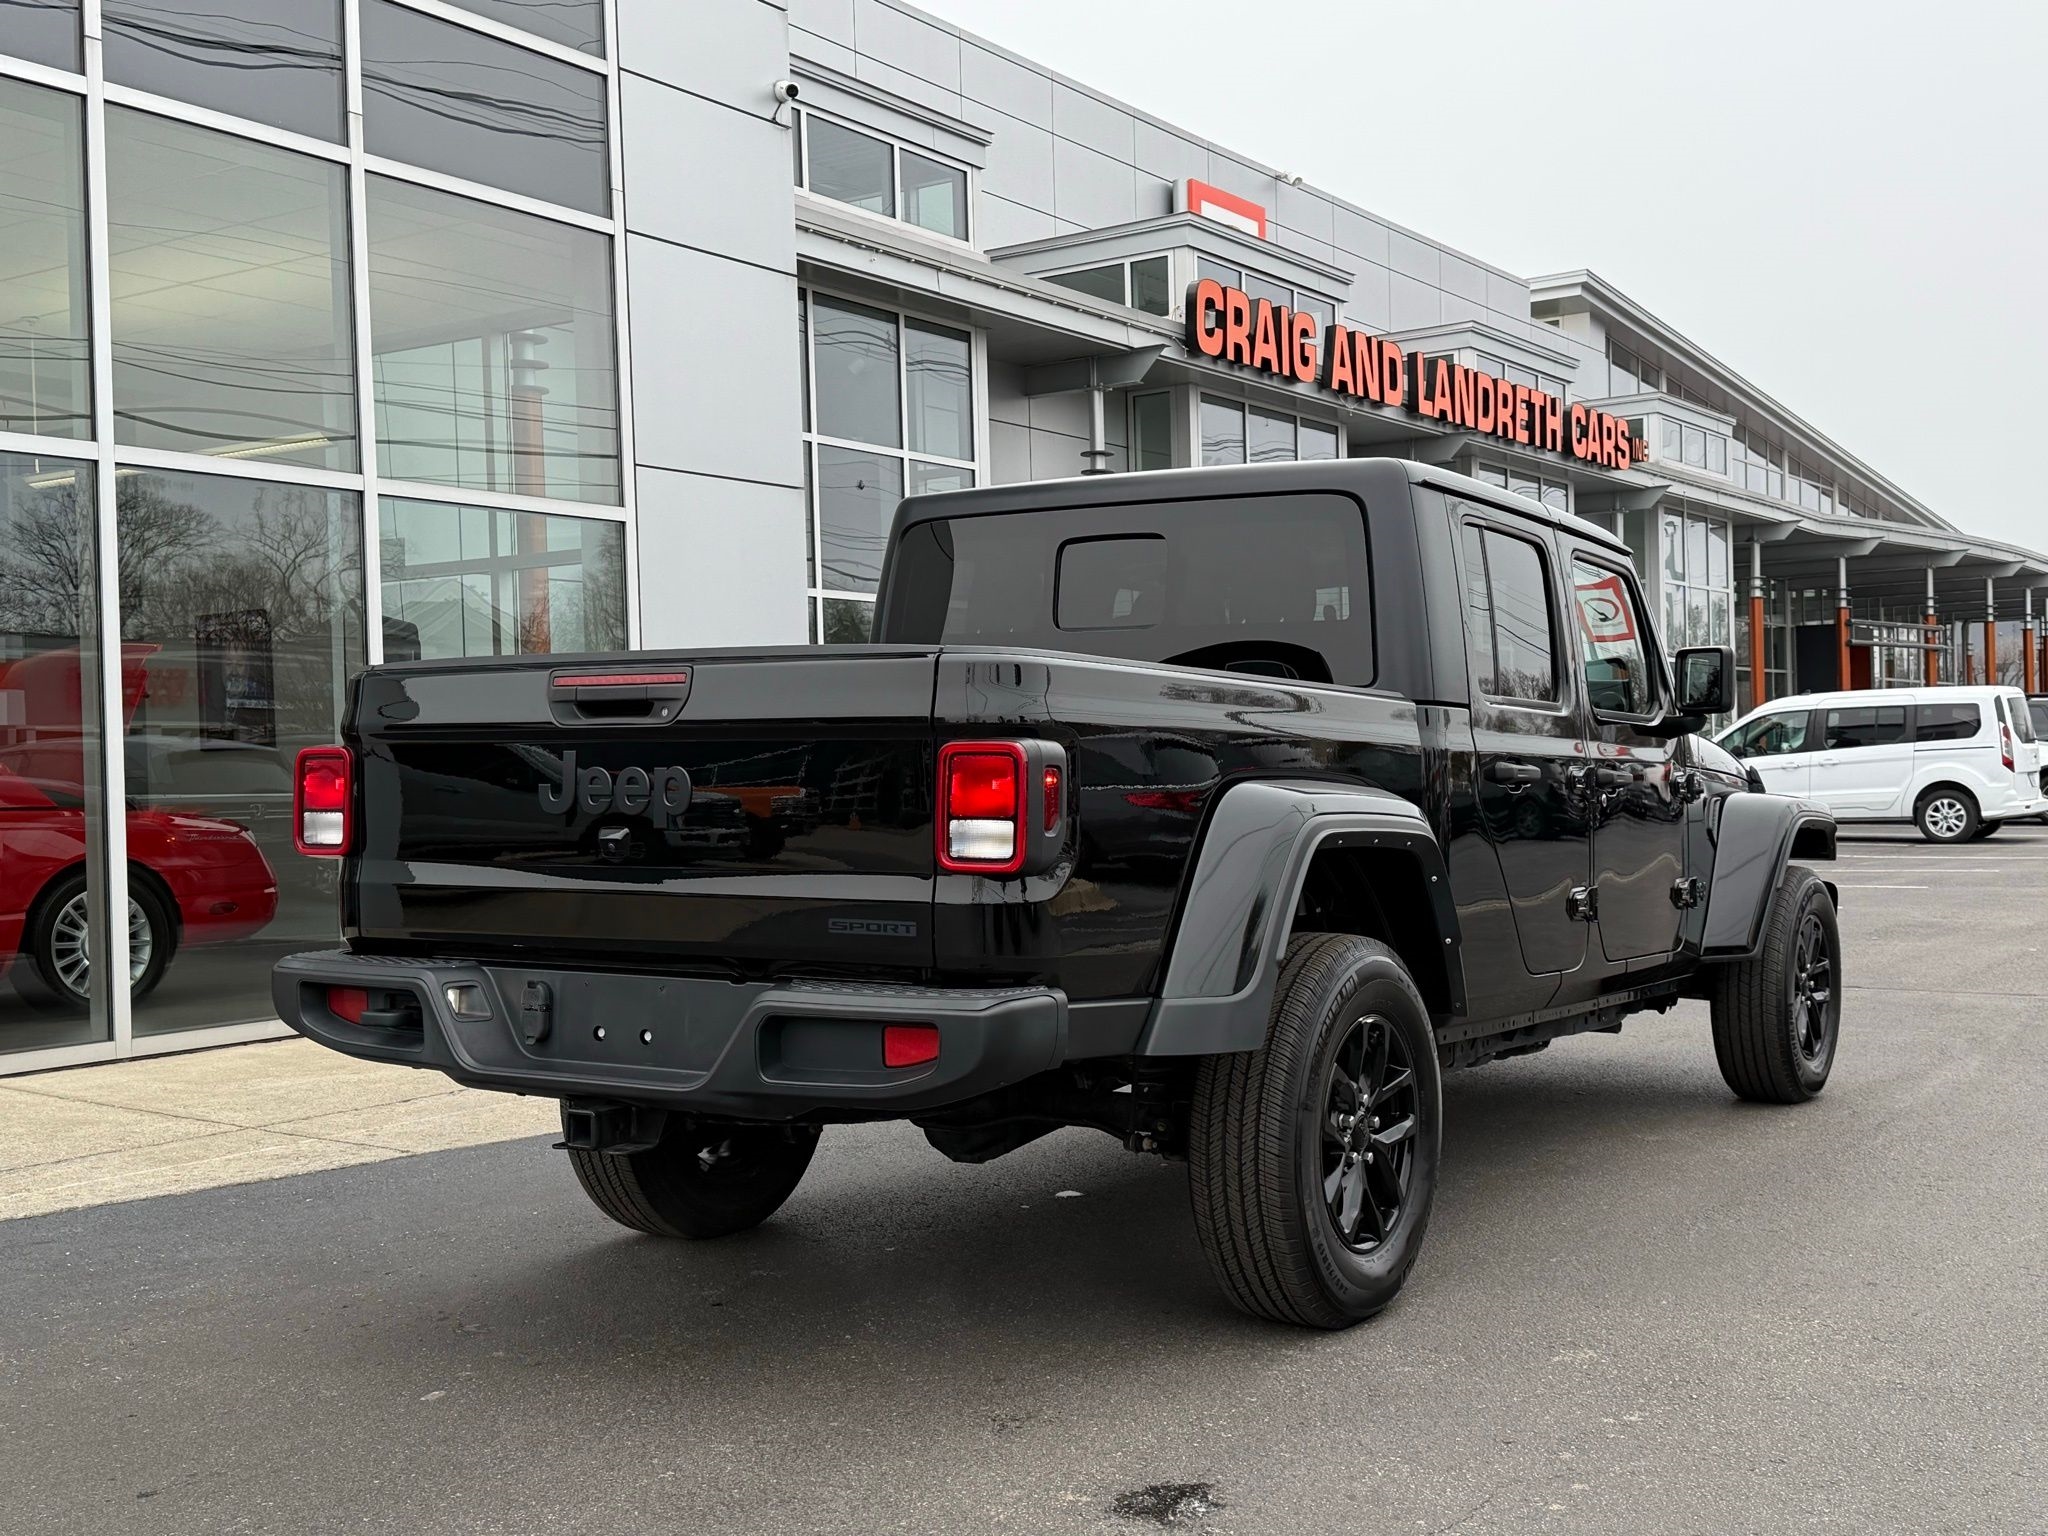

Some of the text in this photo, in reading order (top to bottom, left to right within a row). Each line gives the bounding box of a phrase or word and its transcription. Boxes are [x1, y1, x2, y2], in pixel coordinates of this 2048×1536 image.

[1196, 278, 1317, 383] CRAIG
[1330, 324, 1405, 407] AND
[1417, 351, 1564, 453] LANDRETH
[1571, 403, 1632, 471] CARS
[538, 750, 692, 829] Jeep
[830, 919, 915, 934] SPORT
